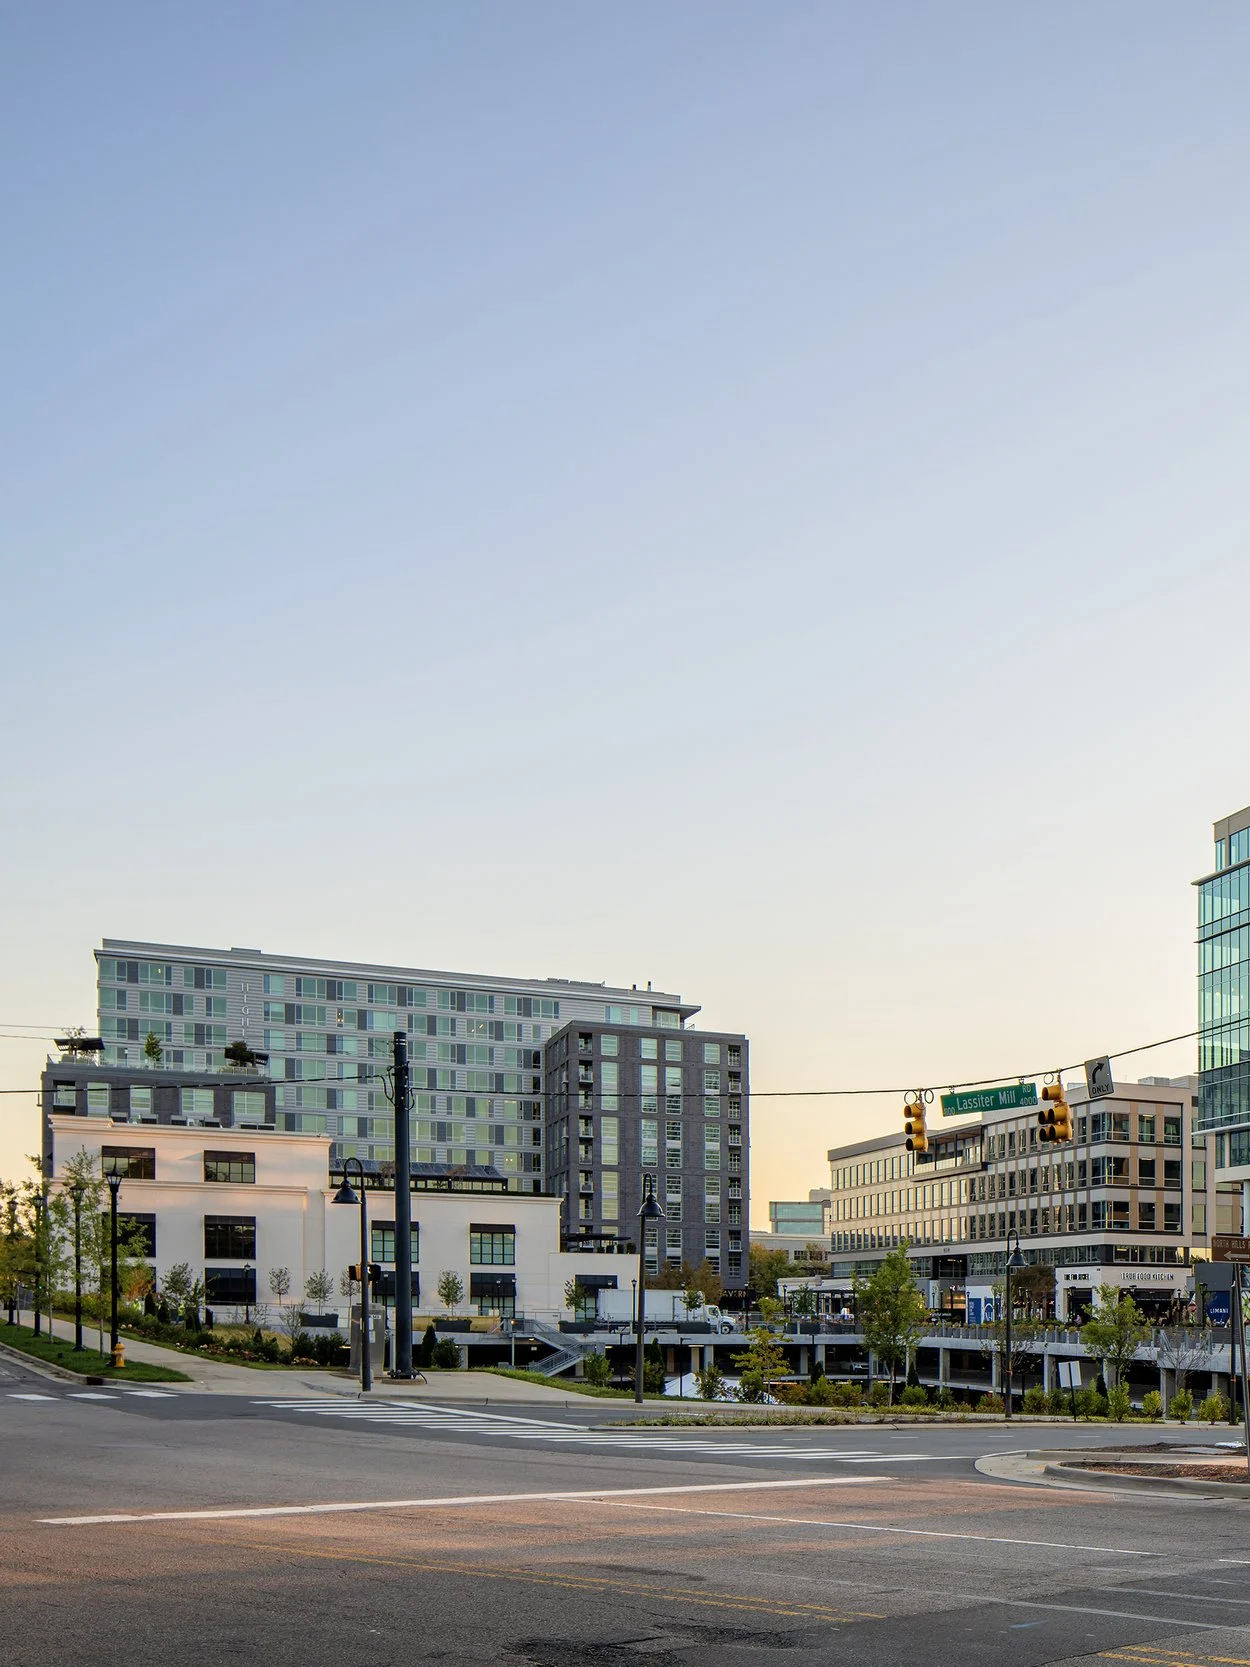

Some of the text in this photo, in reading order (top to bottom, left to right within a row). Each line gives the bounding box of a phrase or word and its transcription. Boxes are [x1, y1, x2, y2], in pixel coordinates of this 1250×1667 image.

[1091, 1084, 1110, 1095] ONLY
[956, 1085, 1031, 1111] Lassiter Mill RD
[1019, 1096, 1037, 1106] 4000
[1213, 1239, 1230, 1248] NORTH
[1231, 1240, 1246, 1249] HILLS
[1137, 1272, 1151, 1280] FOOD
[1152, 1273, 1174, 1281] KITCHEN
